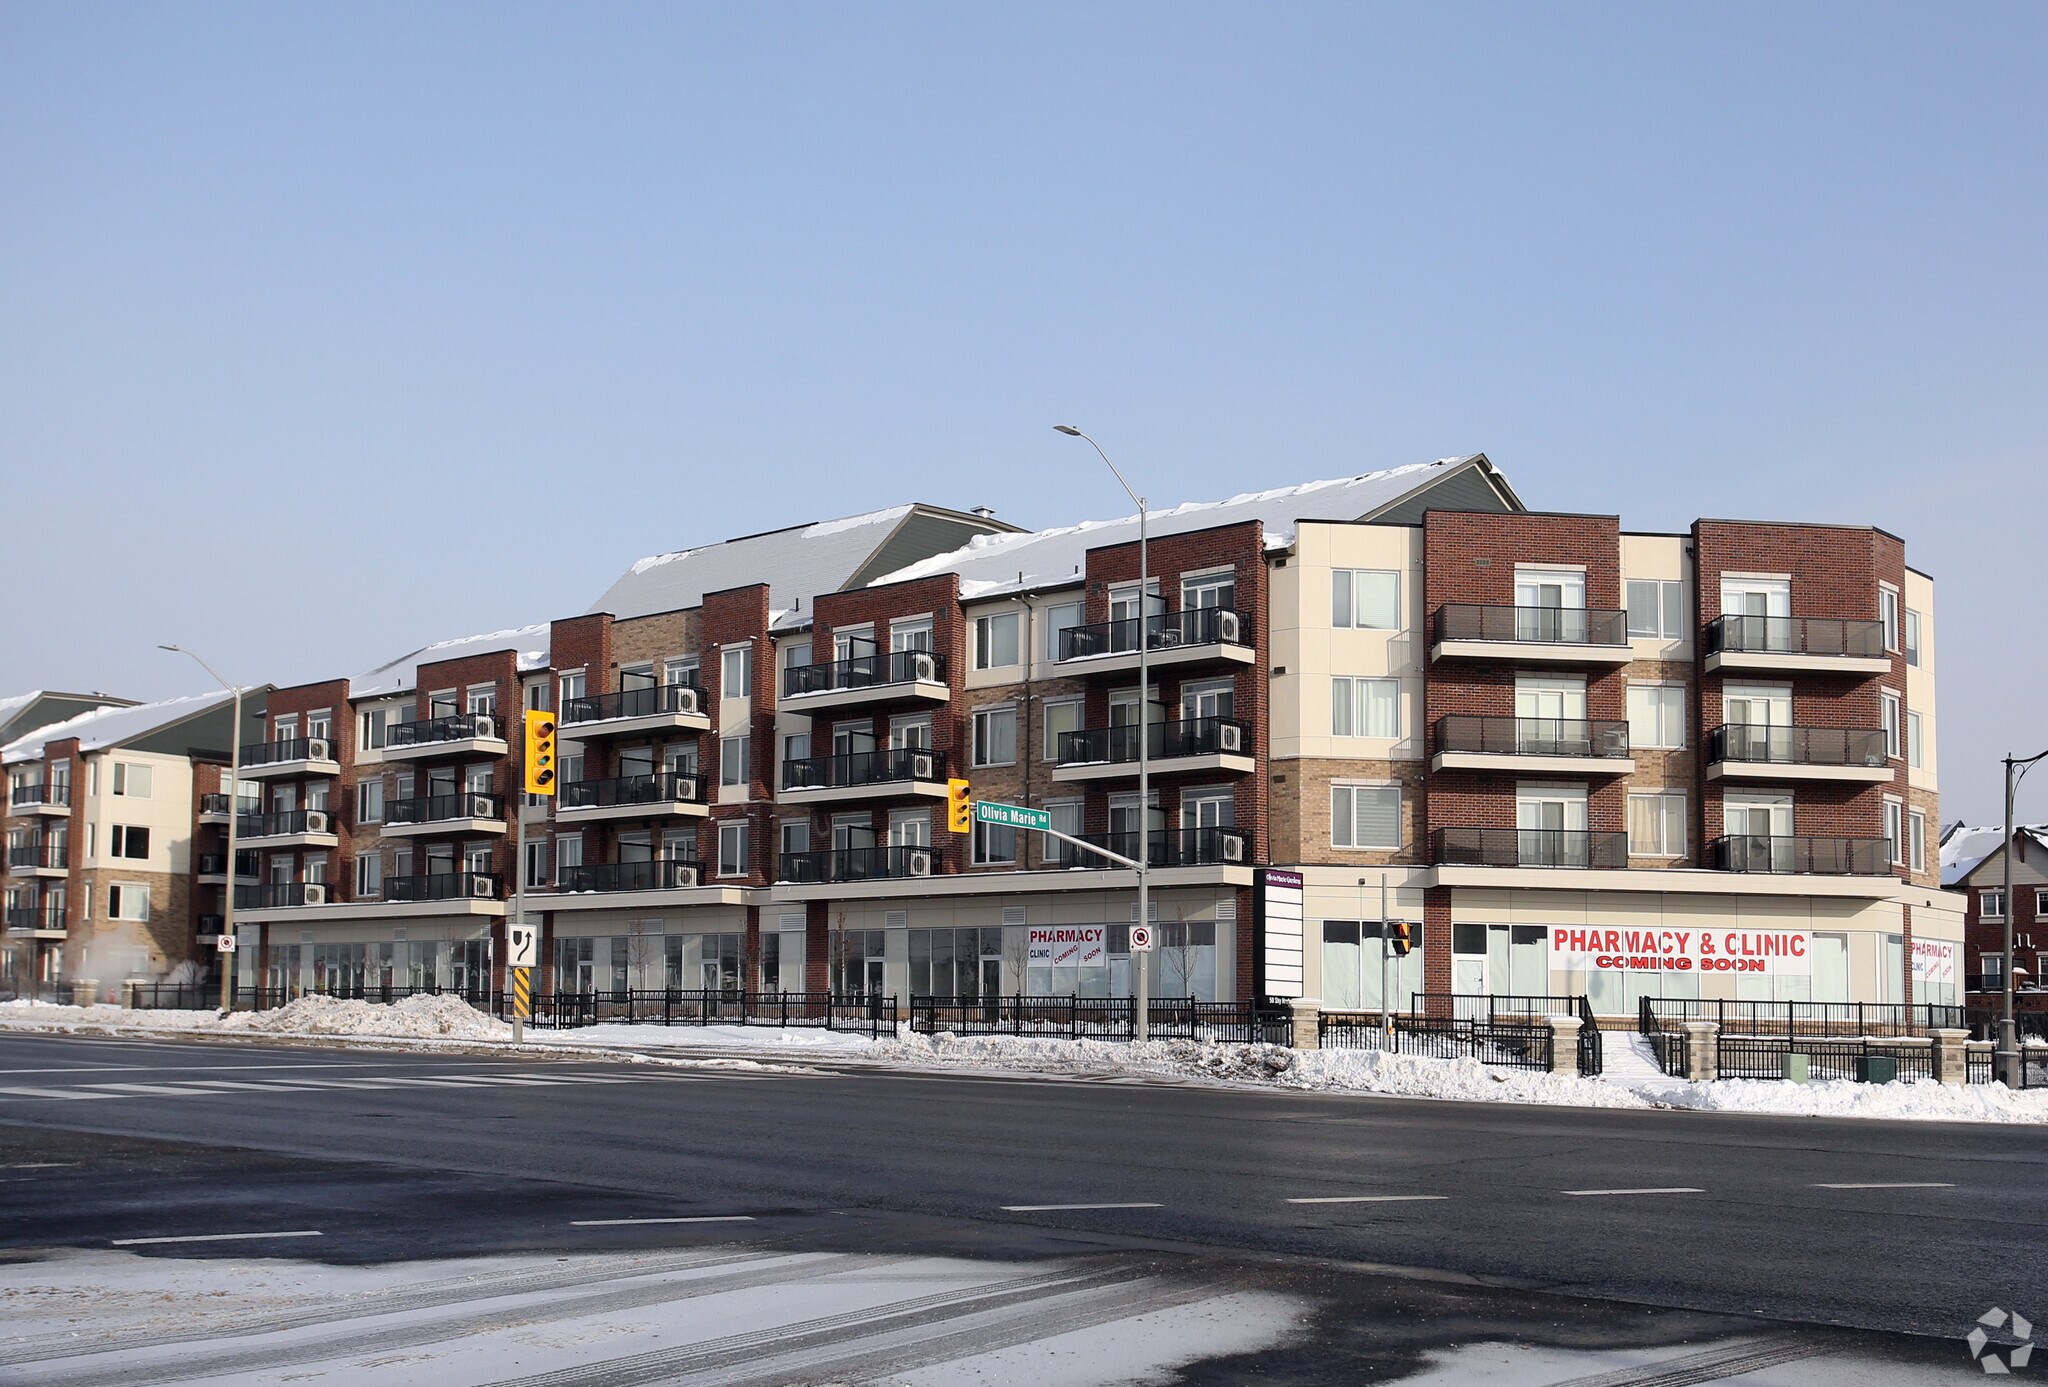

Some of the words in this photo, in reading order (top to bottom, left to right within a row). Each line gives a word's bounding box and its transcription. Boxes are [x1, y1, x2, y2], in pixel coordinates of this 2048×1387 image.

[981, 805, 1008, 822] Olivia
[1010, 809, 1037, 826] Marie
[1038, 814, 1047, 823] Rd
[1029, 928, 1103, 943] PHARMACY
[1553, 929, 1691, 954] PHARMACY
[1699, 932, 1716, 955] &
[1724, 933, 1806, 957] CLINIC
[1029, 949, 1050, 958] CLINIC
[1054, 944, 1079, 964] COMING
[1083, 946, 1101, 962] SOON
[1910, 941, 1952, 958] PHARMACY
[1595, 955, 1692, 970] COMING
[1700, 957, 1766, 972] SOON
